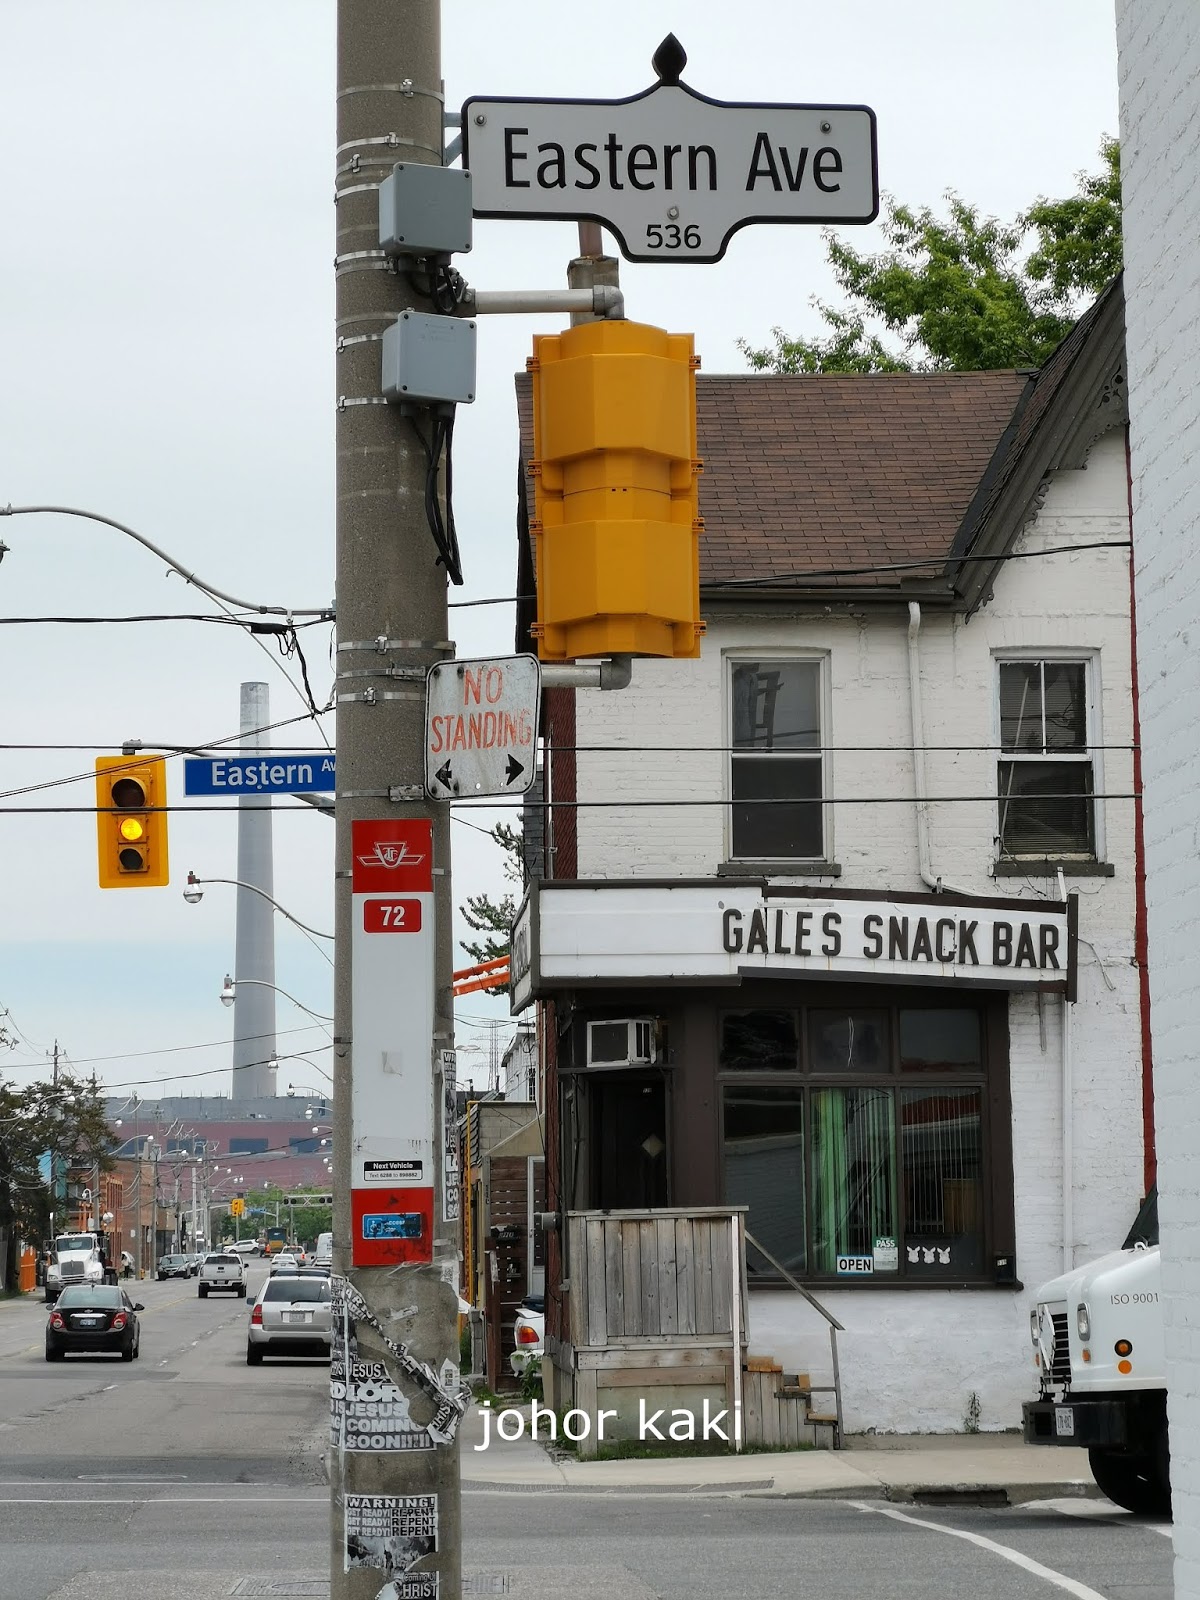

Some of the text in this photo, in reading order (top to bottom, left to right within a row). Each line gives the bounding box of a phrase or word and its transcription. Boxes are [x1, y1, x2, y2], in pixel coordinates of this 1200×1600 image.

[504, 127, 843, 193] Eastern Ave
[645, 224, 702, 249] 536
[464, 666, 503, 706] NO
[430, 707, 532, 753] STANDING
[211, 758, 336, 787] Eastern Av
[380, 905, 406, 927] 72
[722, 907, 1061, 970] GALES SNACK BAR
[373, 1161, 414, 1170] Next Vehicle
[876, 1239, 896, 1248] PASS
[839, 1258, 871, 1272] OPEN
[1110, 1292, 1159, 1305] ISO 9001
[345, 1379, 405, 1402] LOR
[346, 1401, 407, 1417] JESUS
[348, 1498, 435, 1508] WARNING!
[392, 1508, 435, 1517] REPENT
[392, 1517, 435, 1526] REPENT
[392, 1526, 435, 1536] REPENT
[402, 1583, 437, 1598] HRIST
